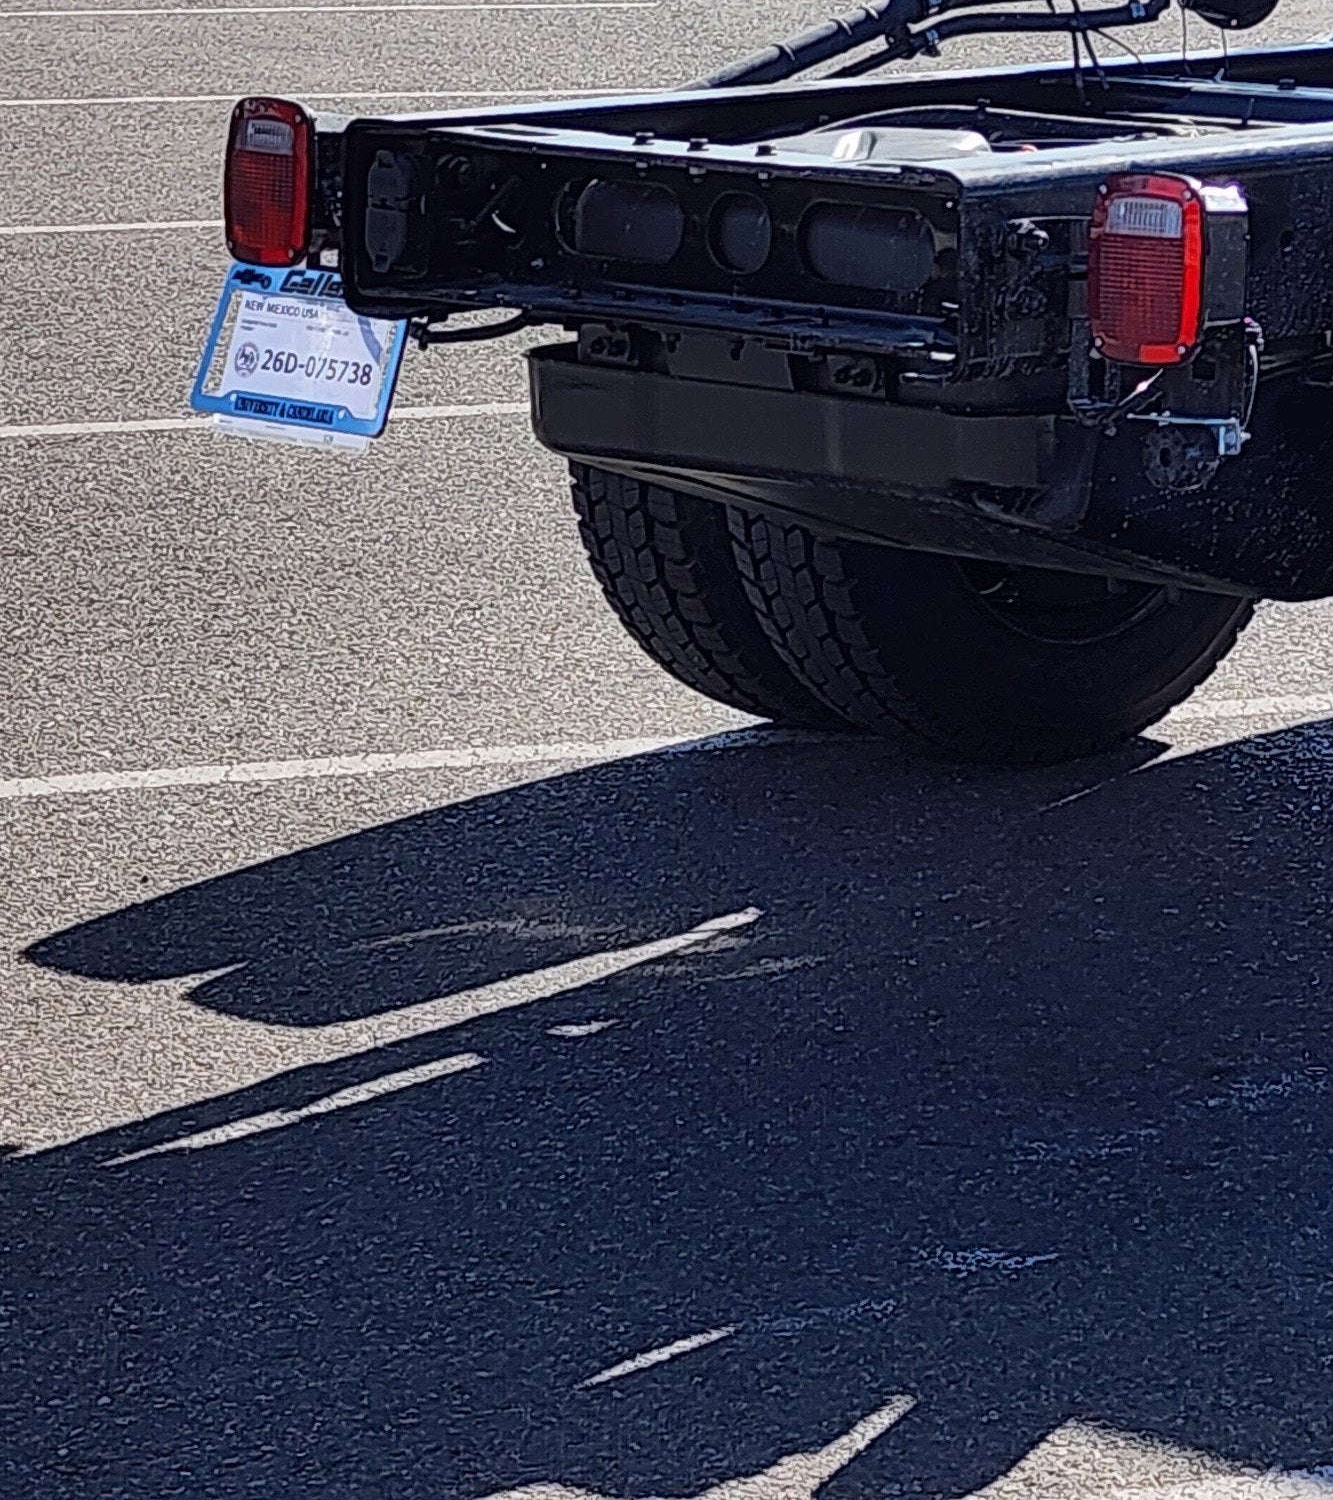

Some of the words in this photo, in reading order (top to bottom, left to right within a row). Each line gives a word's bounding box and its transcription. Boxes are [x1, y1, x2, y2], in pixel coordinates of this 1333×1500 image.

[244, 300, 266, 311] NEW
[266, 303, 300, 317] MEXICO
[301, 308, 320, 319] USA
